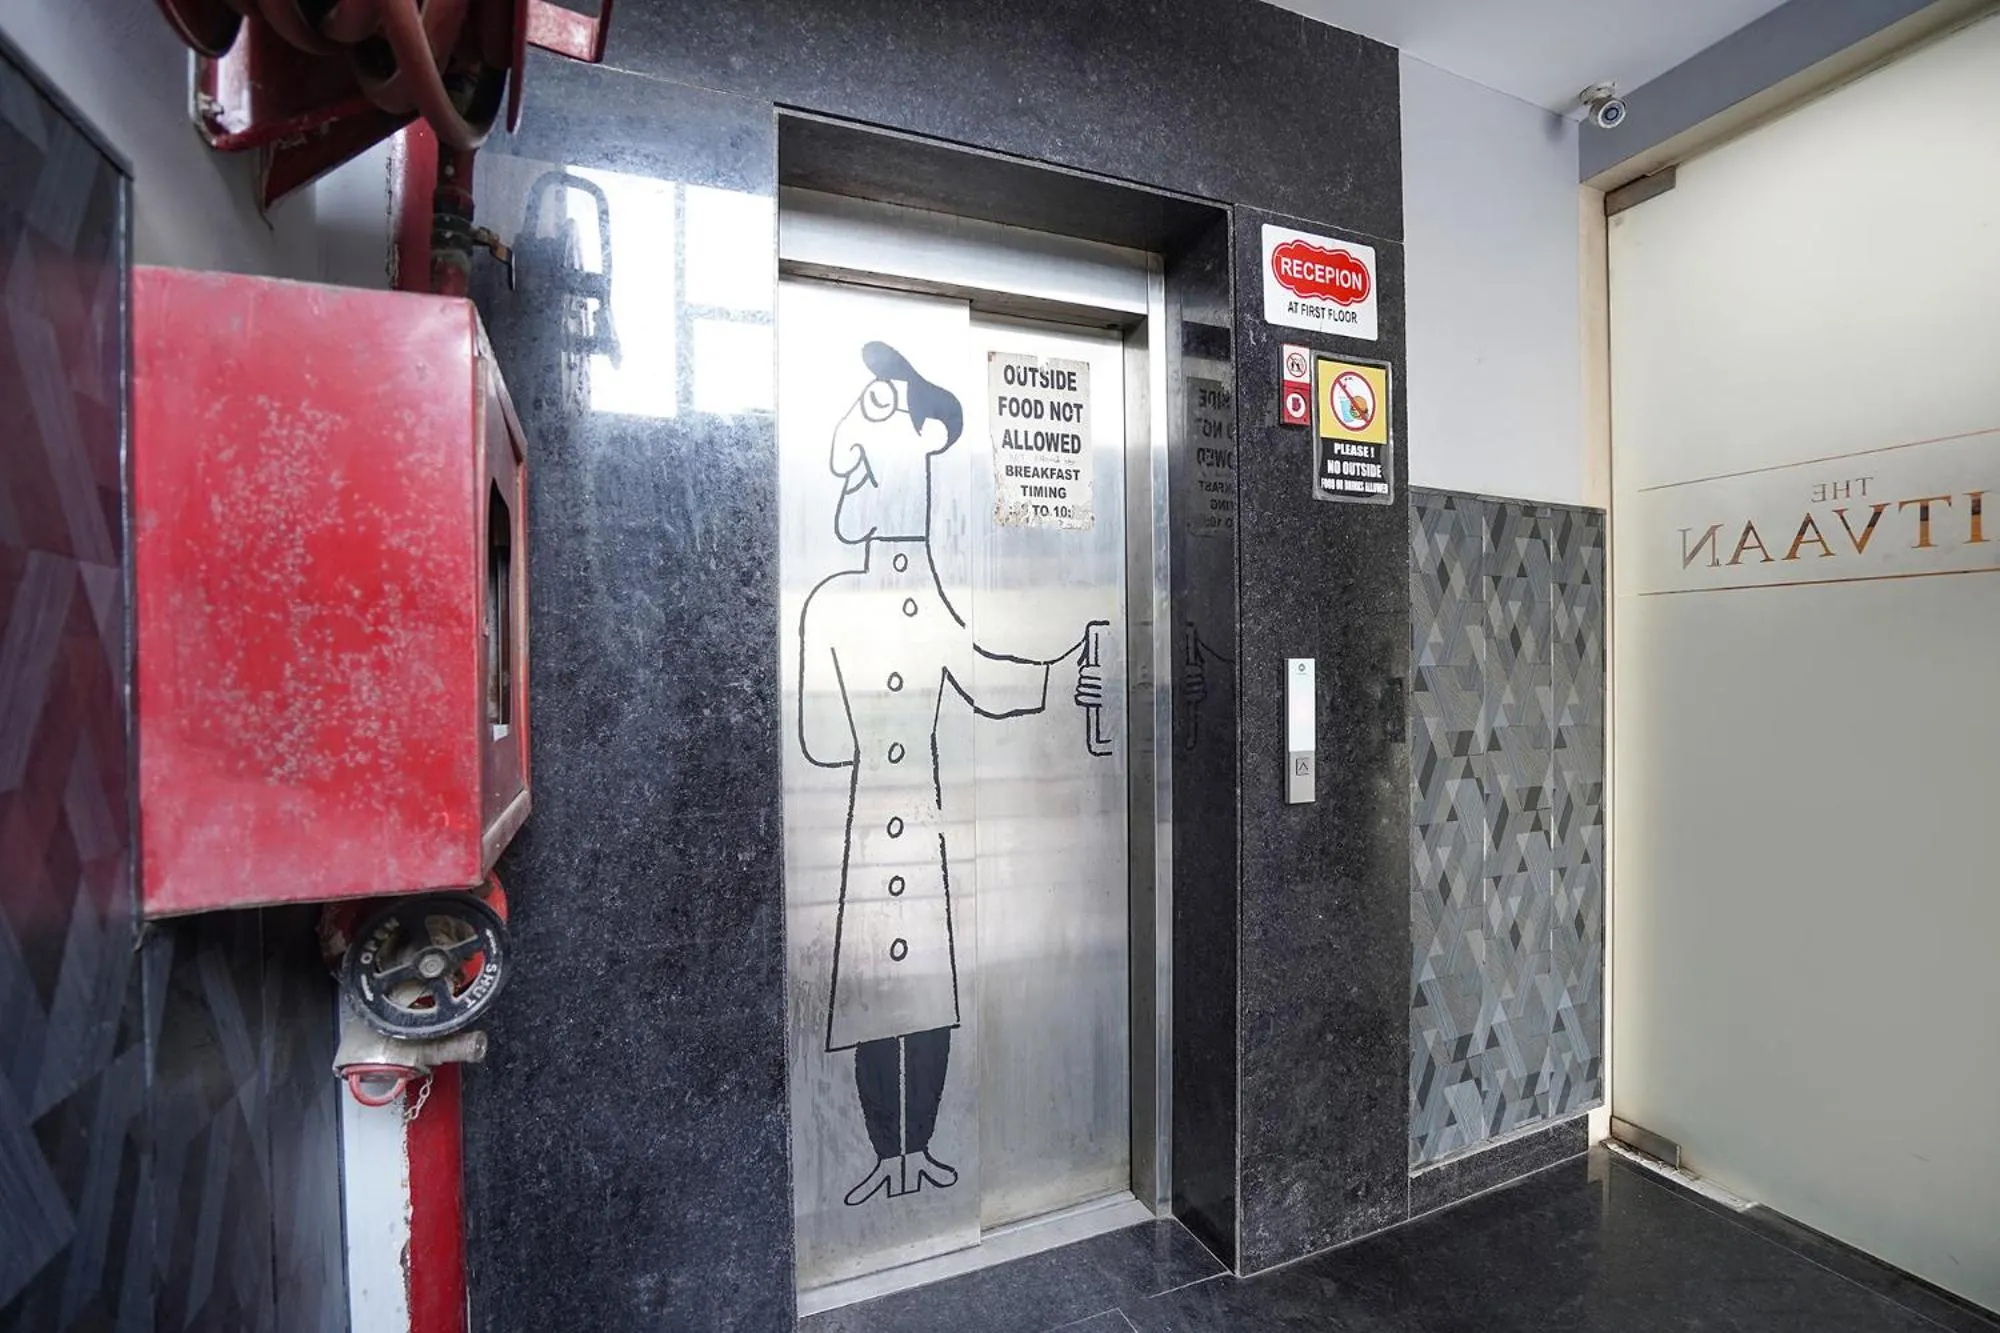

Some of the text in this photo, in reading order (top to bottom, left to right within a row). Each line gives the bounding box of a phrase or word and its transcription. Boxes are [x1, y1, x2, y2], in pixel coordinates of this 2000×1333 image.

[1281, 256, 1362, 291] RECEPION
[1287, 301, 1358, 324] AT FIRST FLOOR
[1003, 364, 1077, 391] OUTSIDE
[998, 396, 1083, 423] FOOD NOT
[1001, 429, 1082, 454] ALLOWED
[1334, 443, 1369, 458] PLEASE
[1005, 465, 1080, 481] BREAKFAST
[1327, 459, 1382, 478] NO OUTSIDE
[1021, 485, 1067, 499] TIMING
[1032, 505, 1050, 517] TO
[464, 962, 497, 1009] SHUT
